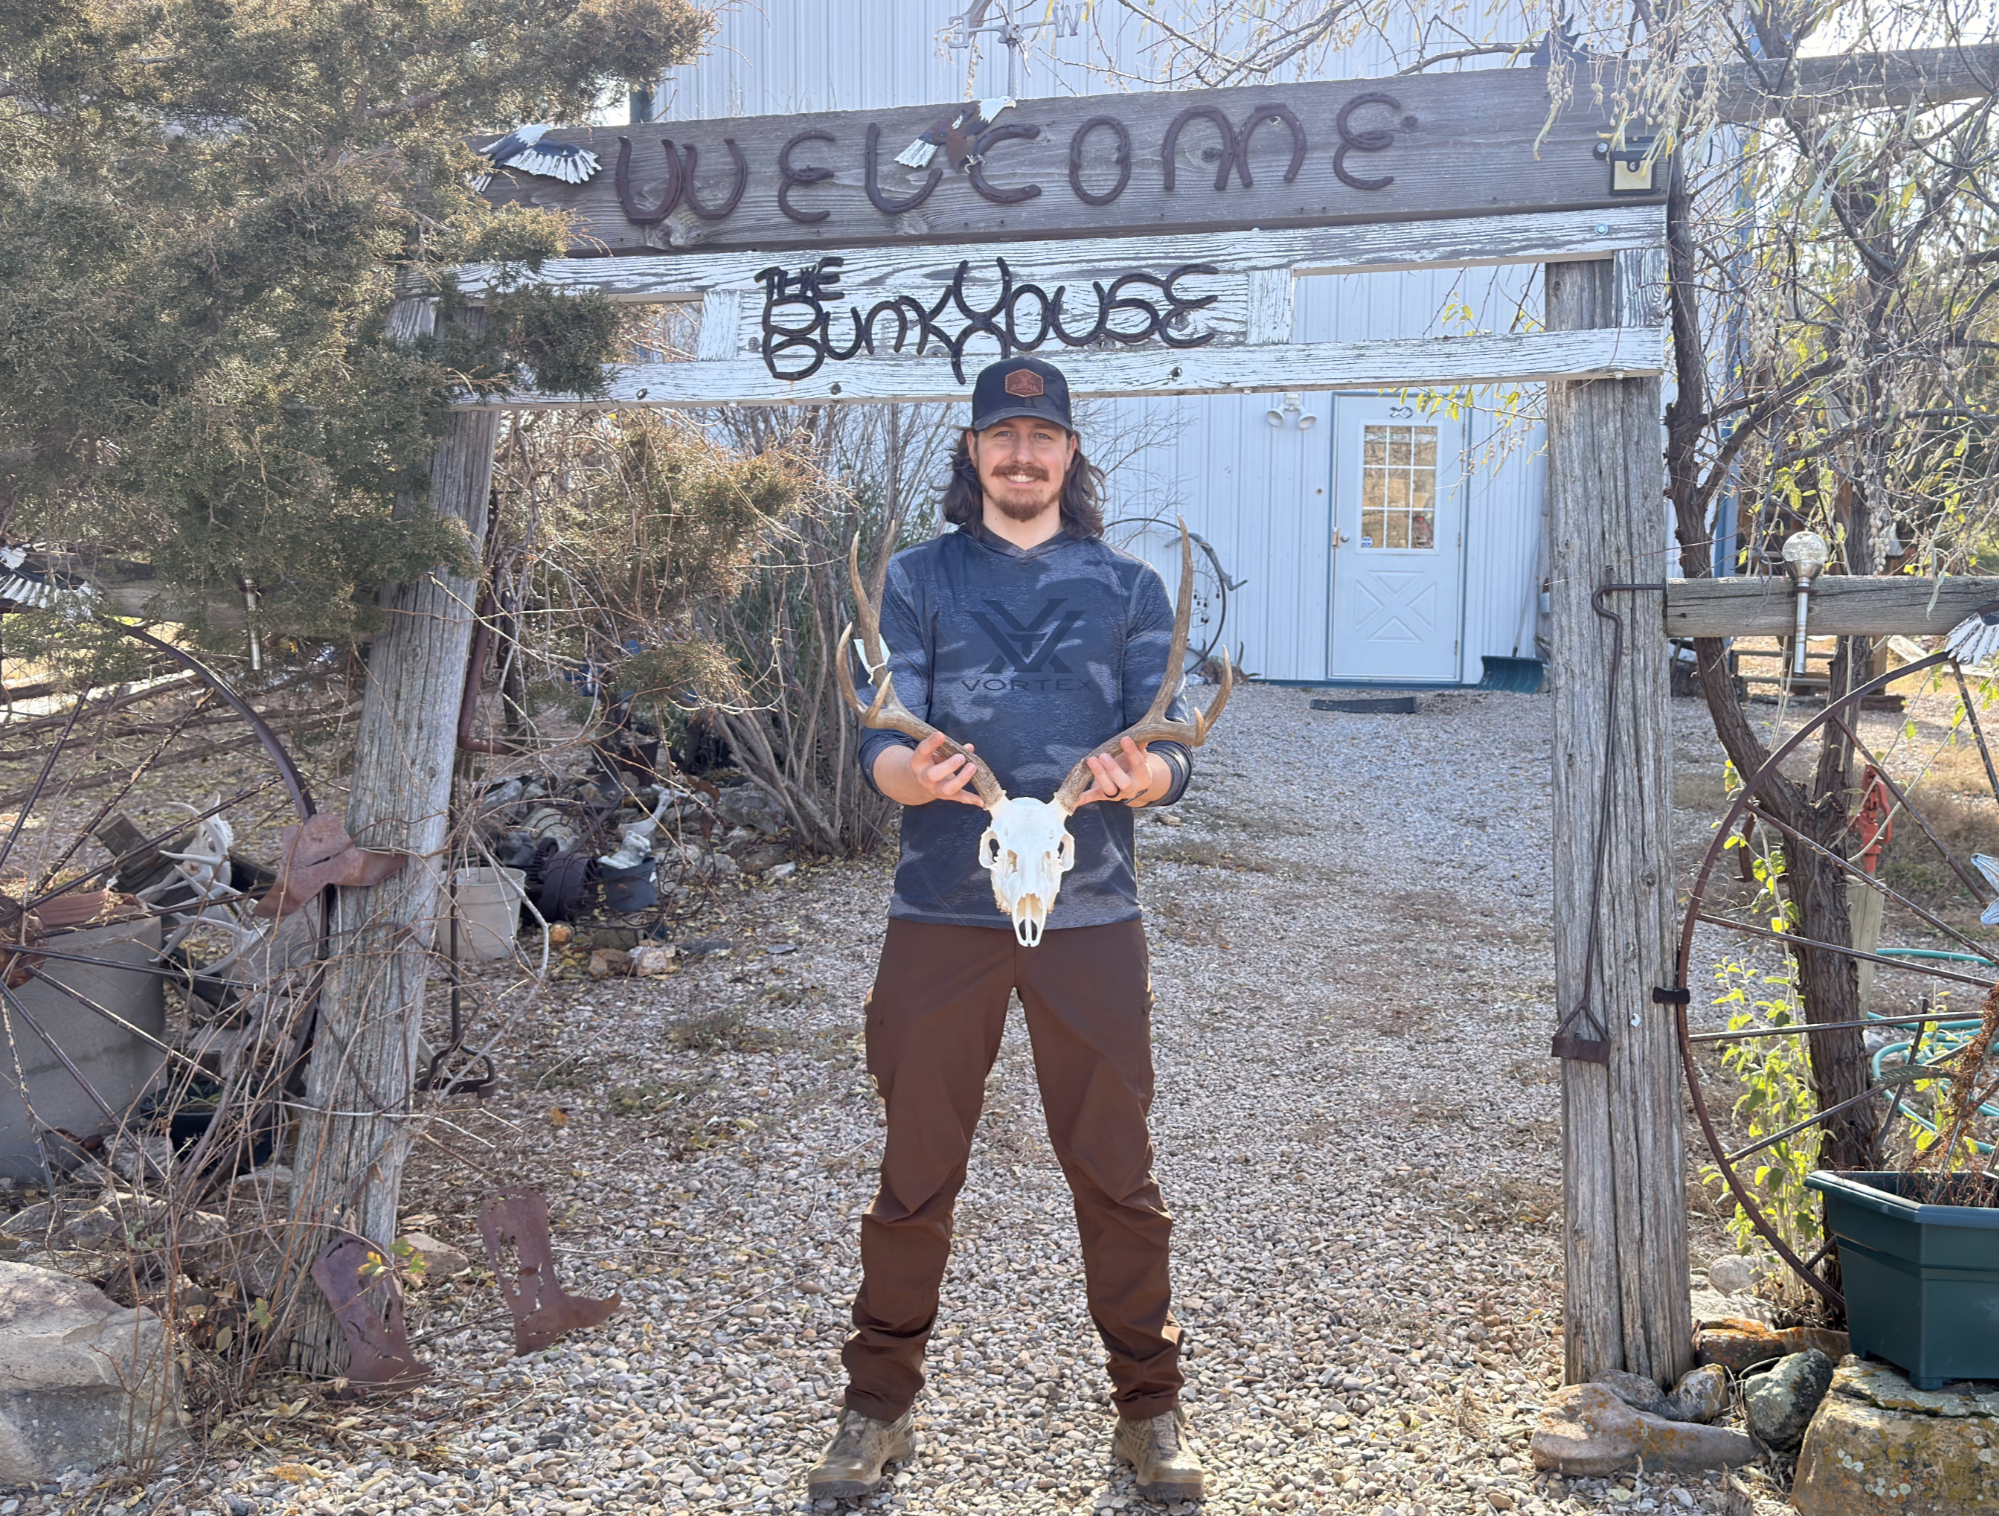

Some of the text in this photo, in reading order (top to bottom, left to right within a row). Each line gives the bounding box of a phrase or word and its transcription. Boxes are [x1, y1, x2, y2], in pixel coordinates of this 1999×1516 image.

[615, 91, 1400, 224] WELCOME
[754, 256, 845, 301] THE
[762, 257, 1219, 385] BUNKHOUSE
[961, 678, 1094, 692] VORTEX
